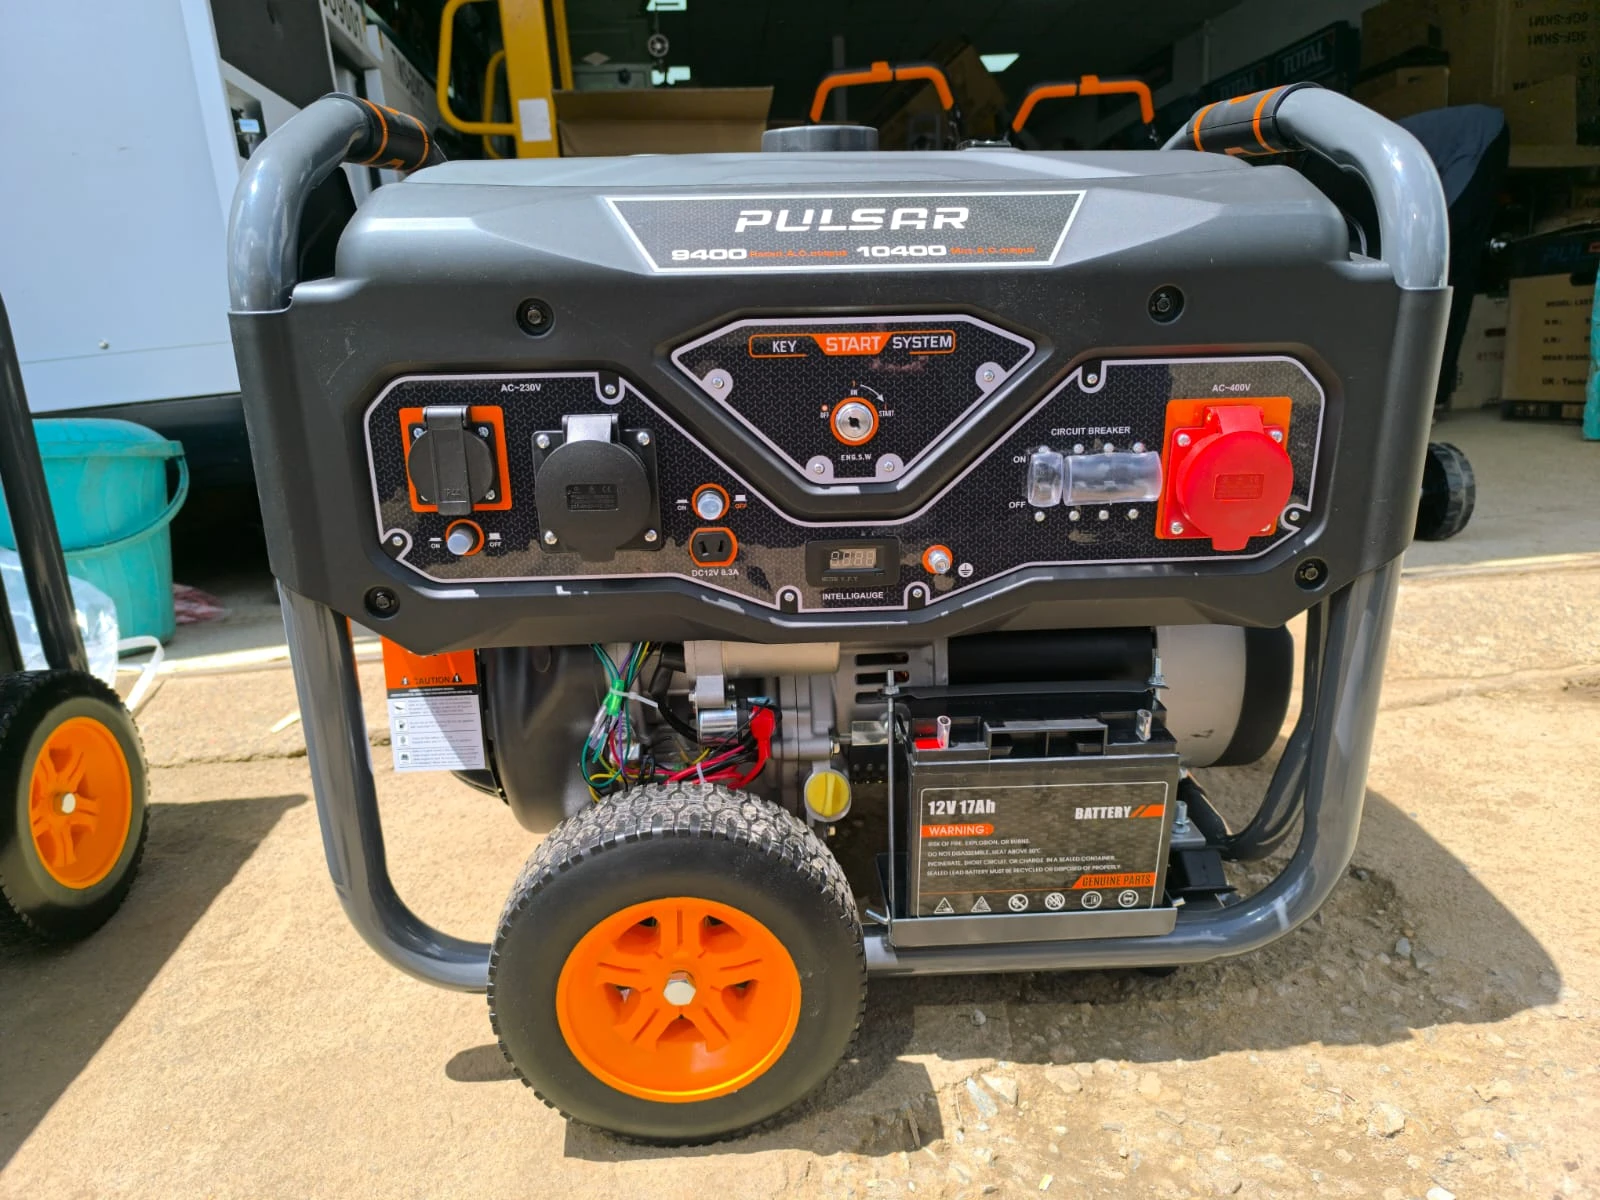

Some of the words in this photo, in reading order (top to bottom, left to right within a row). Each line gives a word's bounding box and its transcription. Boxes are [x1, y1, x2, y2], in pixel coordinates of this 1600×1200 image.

[1282, 41, 1325, 76] TOTAL
[735, 207, 969, 232] PULSAR
[672, 248, 748, 261] 9400
[857, 245, 947, 257] 10400
[773, 341, 797, 353] KEY
[826, 336, 881, 351] START
[893, 336, 952, 348] SYSTEM
[879, 409, 895, 417] START
[1051, 427, 1085, 436] CIRCUIT
[1088, 426, 1131, 435] BREAKER
[1013, 456, 1027, 464] ON
[1009, 501, 1026, 509] OFF
[692, 569, 719, 577] DC12V
[720, 568, 740, 576] 8.3A
[822, 592, 884, 601] INTELLIGAUGE
[928, 800, 957, 815] 12V
[959, 799, 996, 814] 17Ah
[1075, 806, 1132, 819] BATTERY
[1082, 874, 1121, 886] GENUINE
[1123, 874, 1151, 885] PARTS
